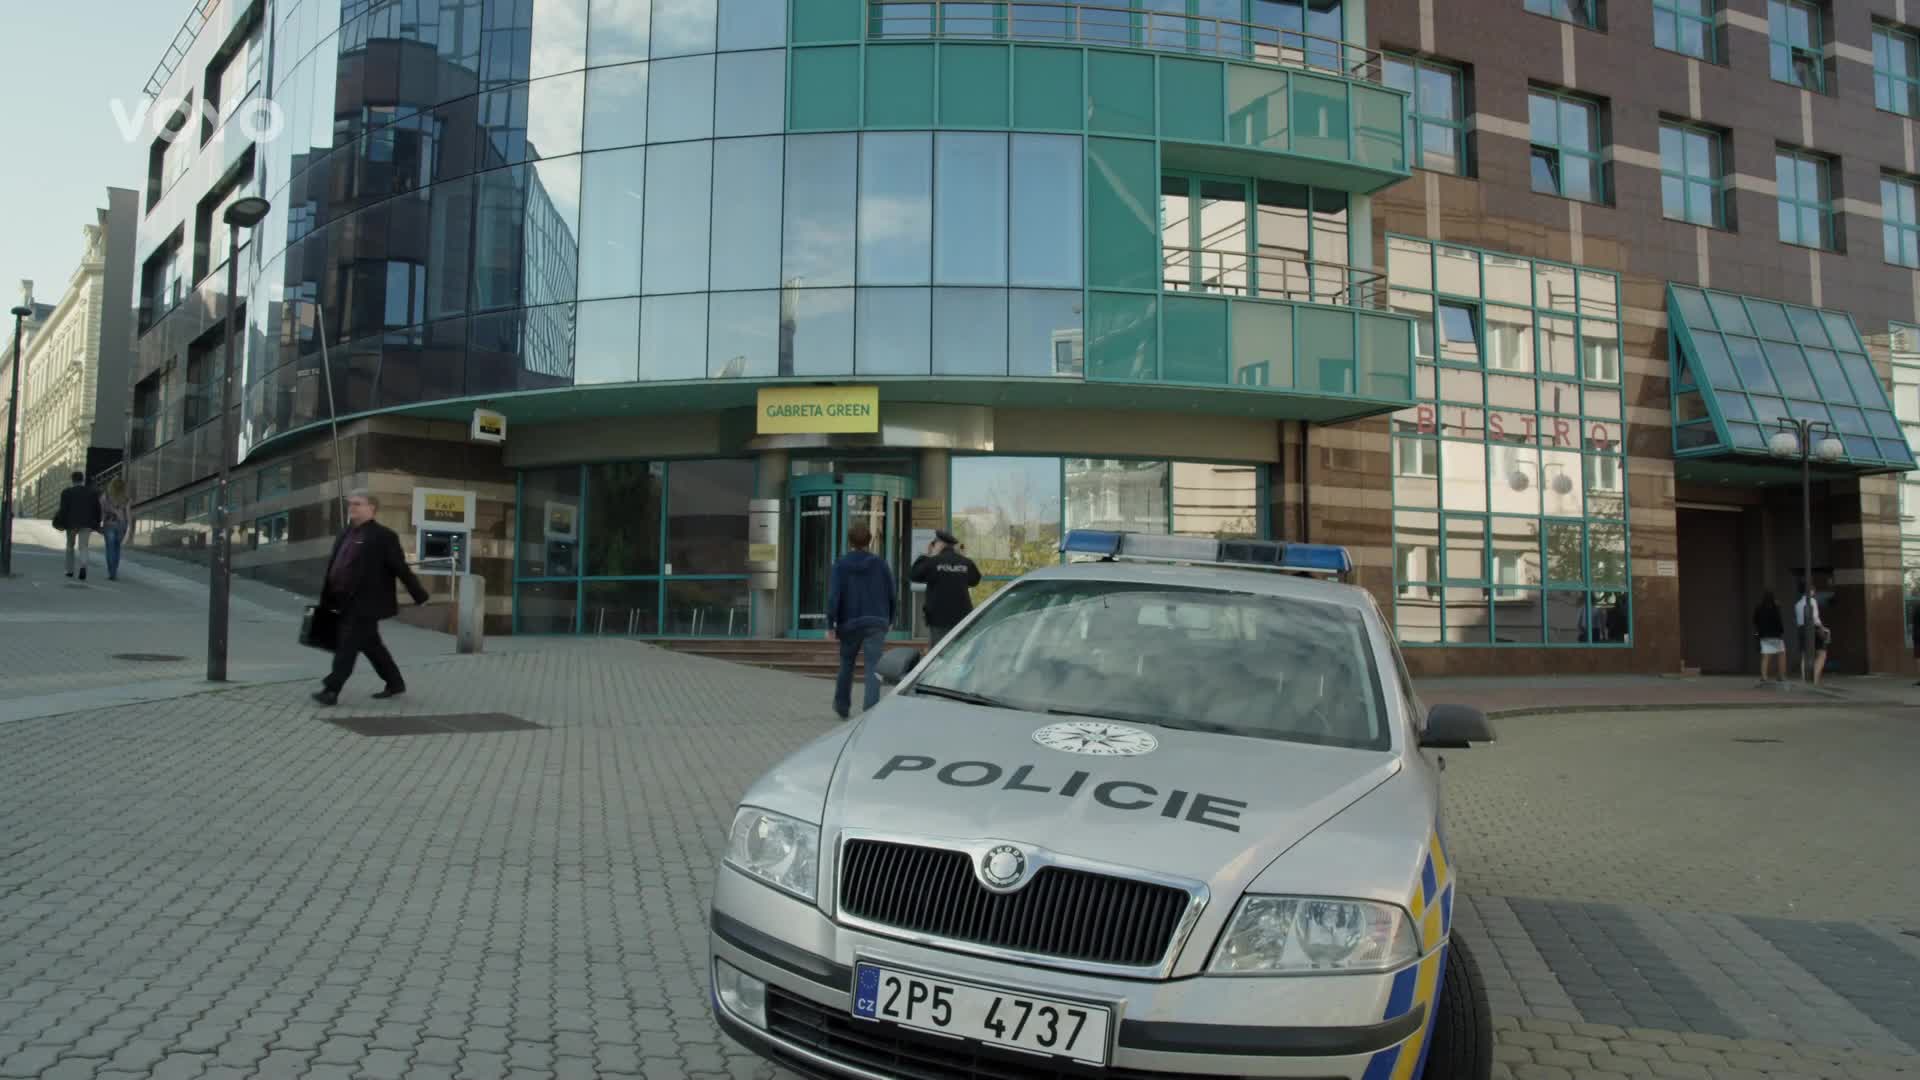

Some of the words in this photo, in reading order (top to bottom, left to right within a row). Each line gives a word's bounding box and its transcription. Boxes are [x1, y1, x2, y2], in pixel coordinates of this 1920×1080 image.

[766, 404, 823, 418] GABRETA
[826, 403, 871, 417] GREEN
[1416, 406, 1609, 448] BISTRO
[871, 755, 1248, 833] POLICIE
[858, 999, 874, 1012] CZ
[882, 976, 954, 1027] 2P5
[983, 997, 1088, 1051] 4737
